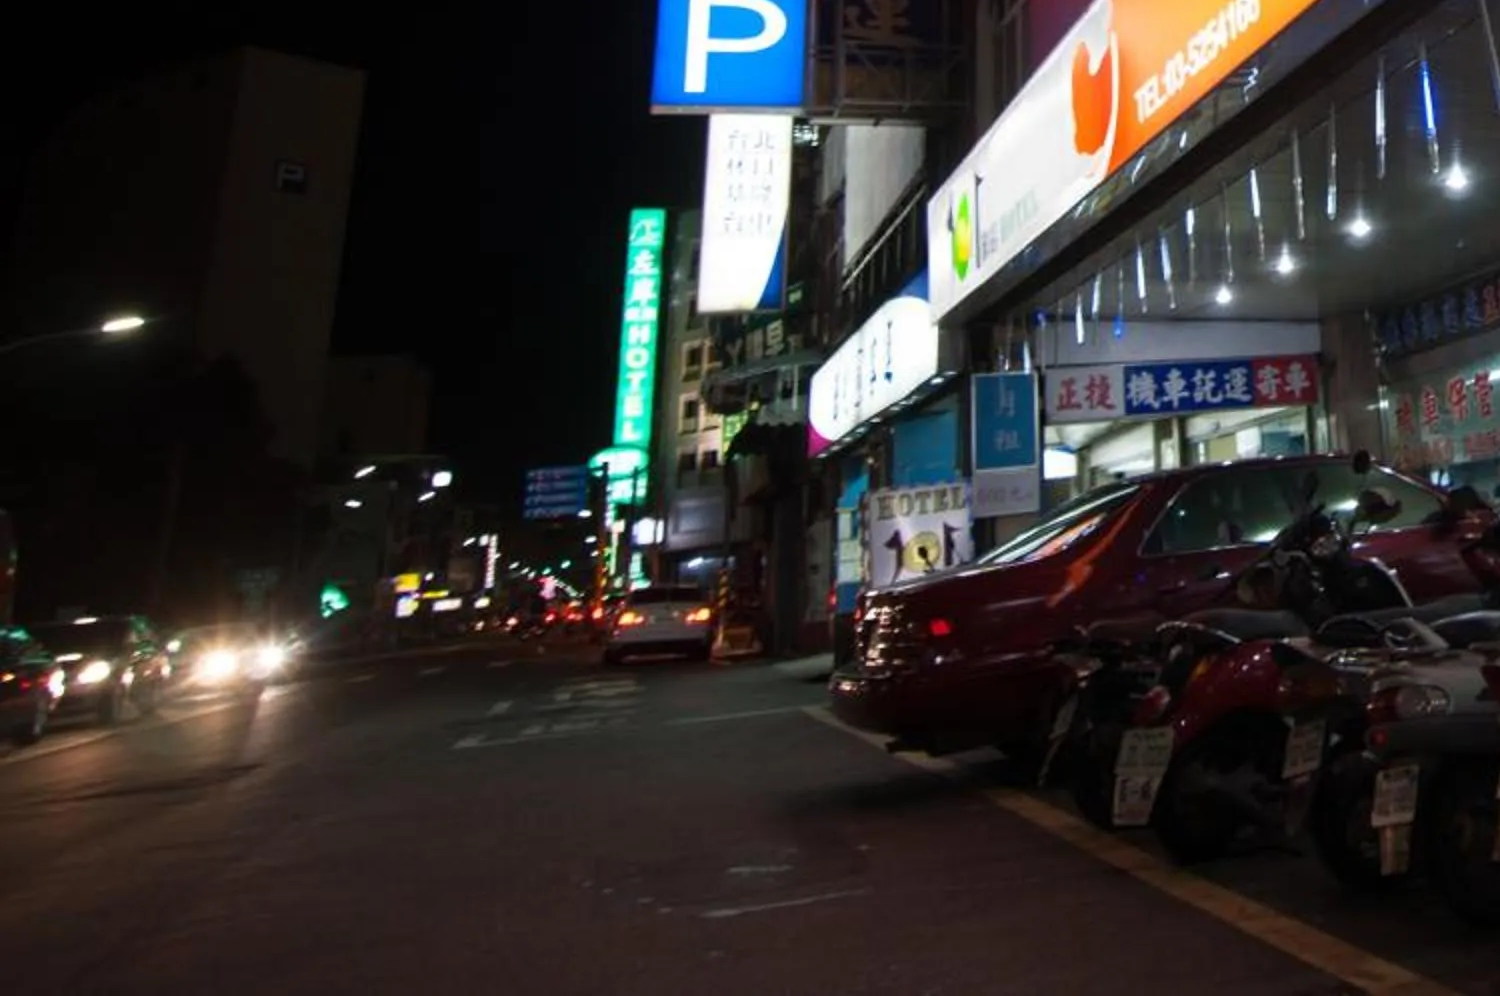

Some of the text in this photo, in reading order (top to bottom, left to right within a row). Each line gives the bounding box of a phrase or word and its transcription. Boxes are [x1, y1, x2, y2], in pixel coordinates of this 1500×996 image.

[620, 326, 651, 443] HOTEL
[1126, 366, 1252, 409] 機車託運
[876, 486, 967, 521] HOTEL
